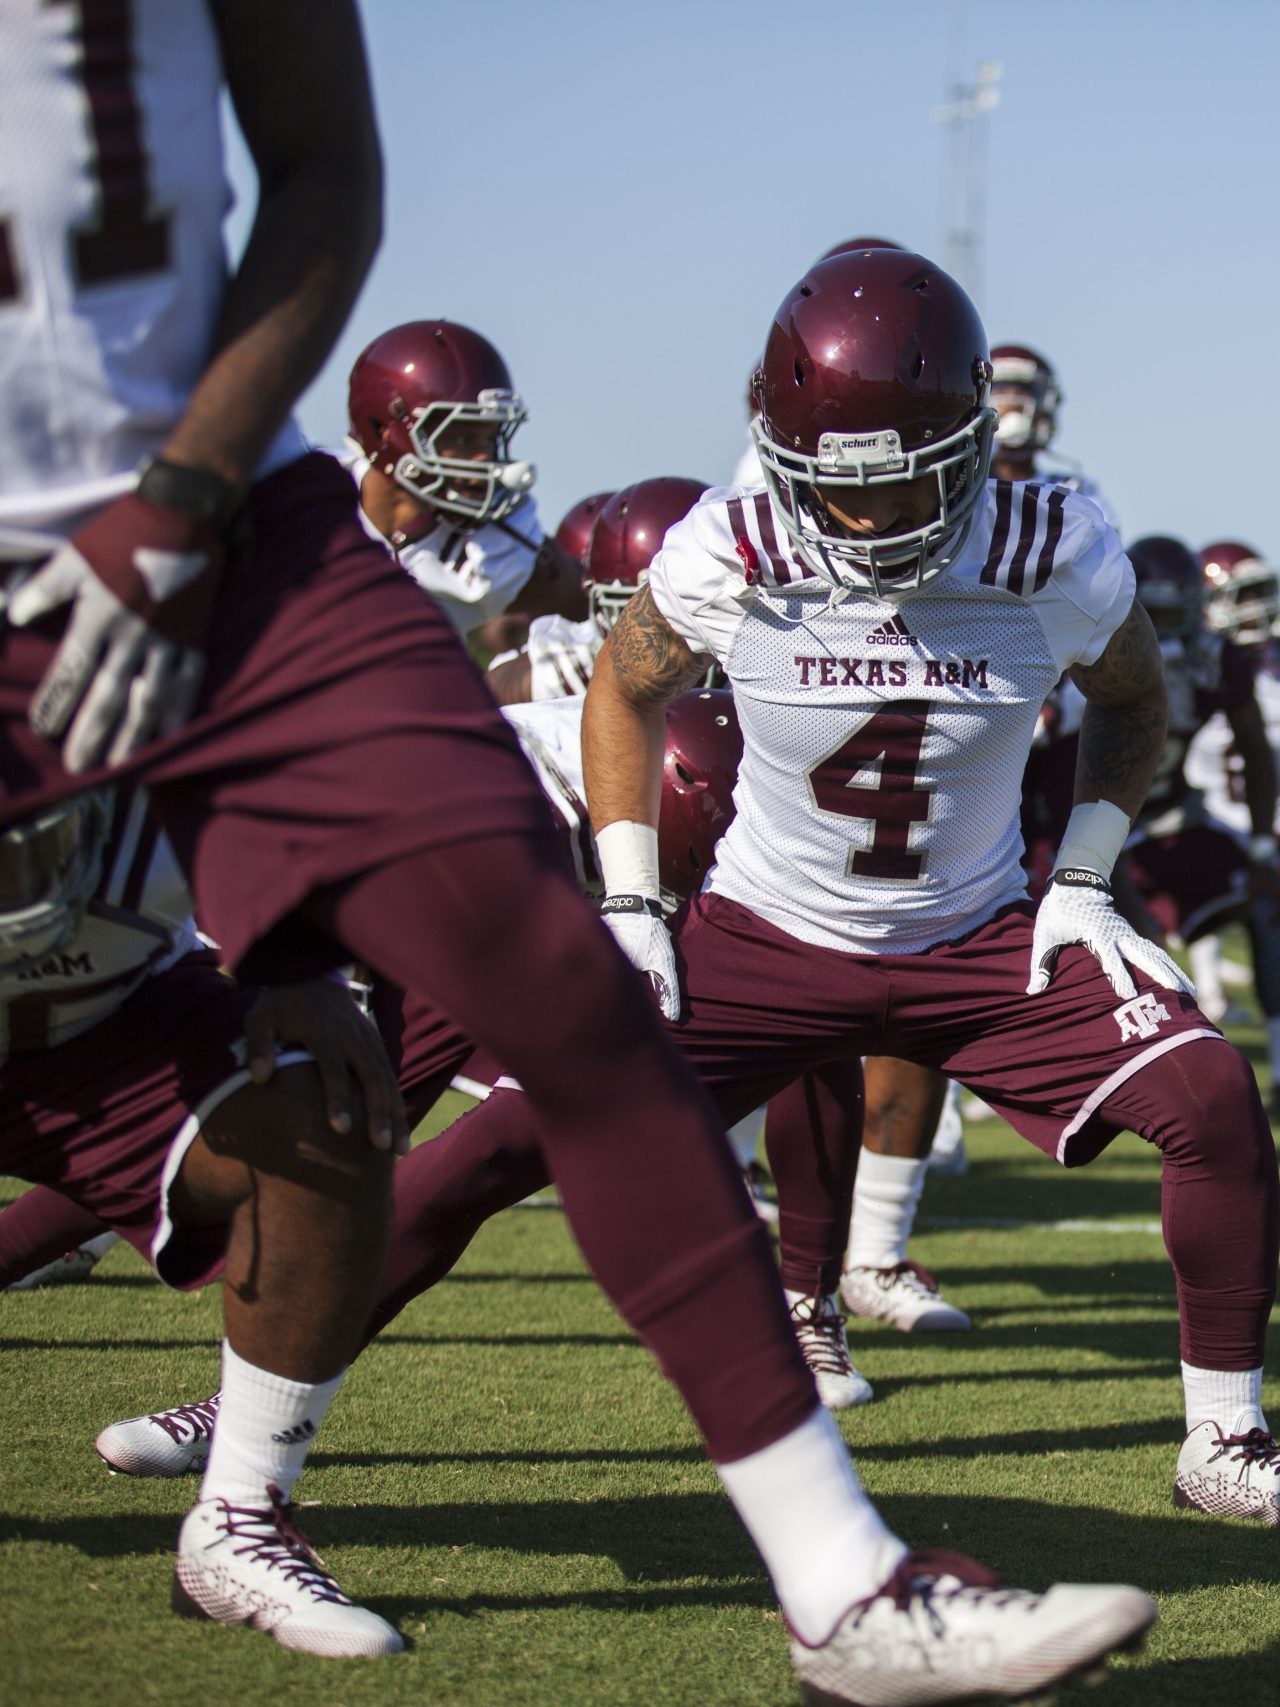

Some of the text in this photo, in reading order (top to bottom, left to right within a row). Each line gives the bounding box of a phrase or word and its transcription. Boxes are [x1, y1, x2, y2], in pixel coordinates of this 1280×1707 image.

[841, 437, 877, 449] schutt
[866, 633, 918, 646] adidas
[794, 656, 989, 689] TEXAS A&M
[802, 698, 938, 887] 4
[604, 897, 634, 909] adize
